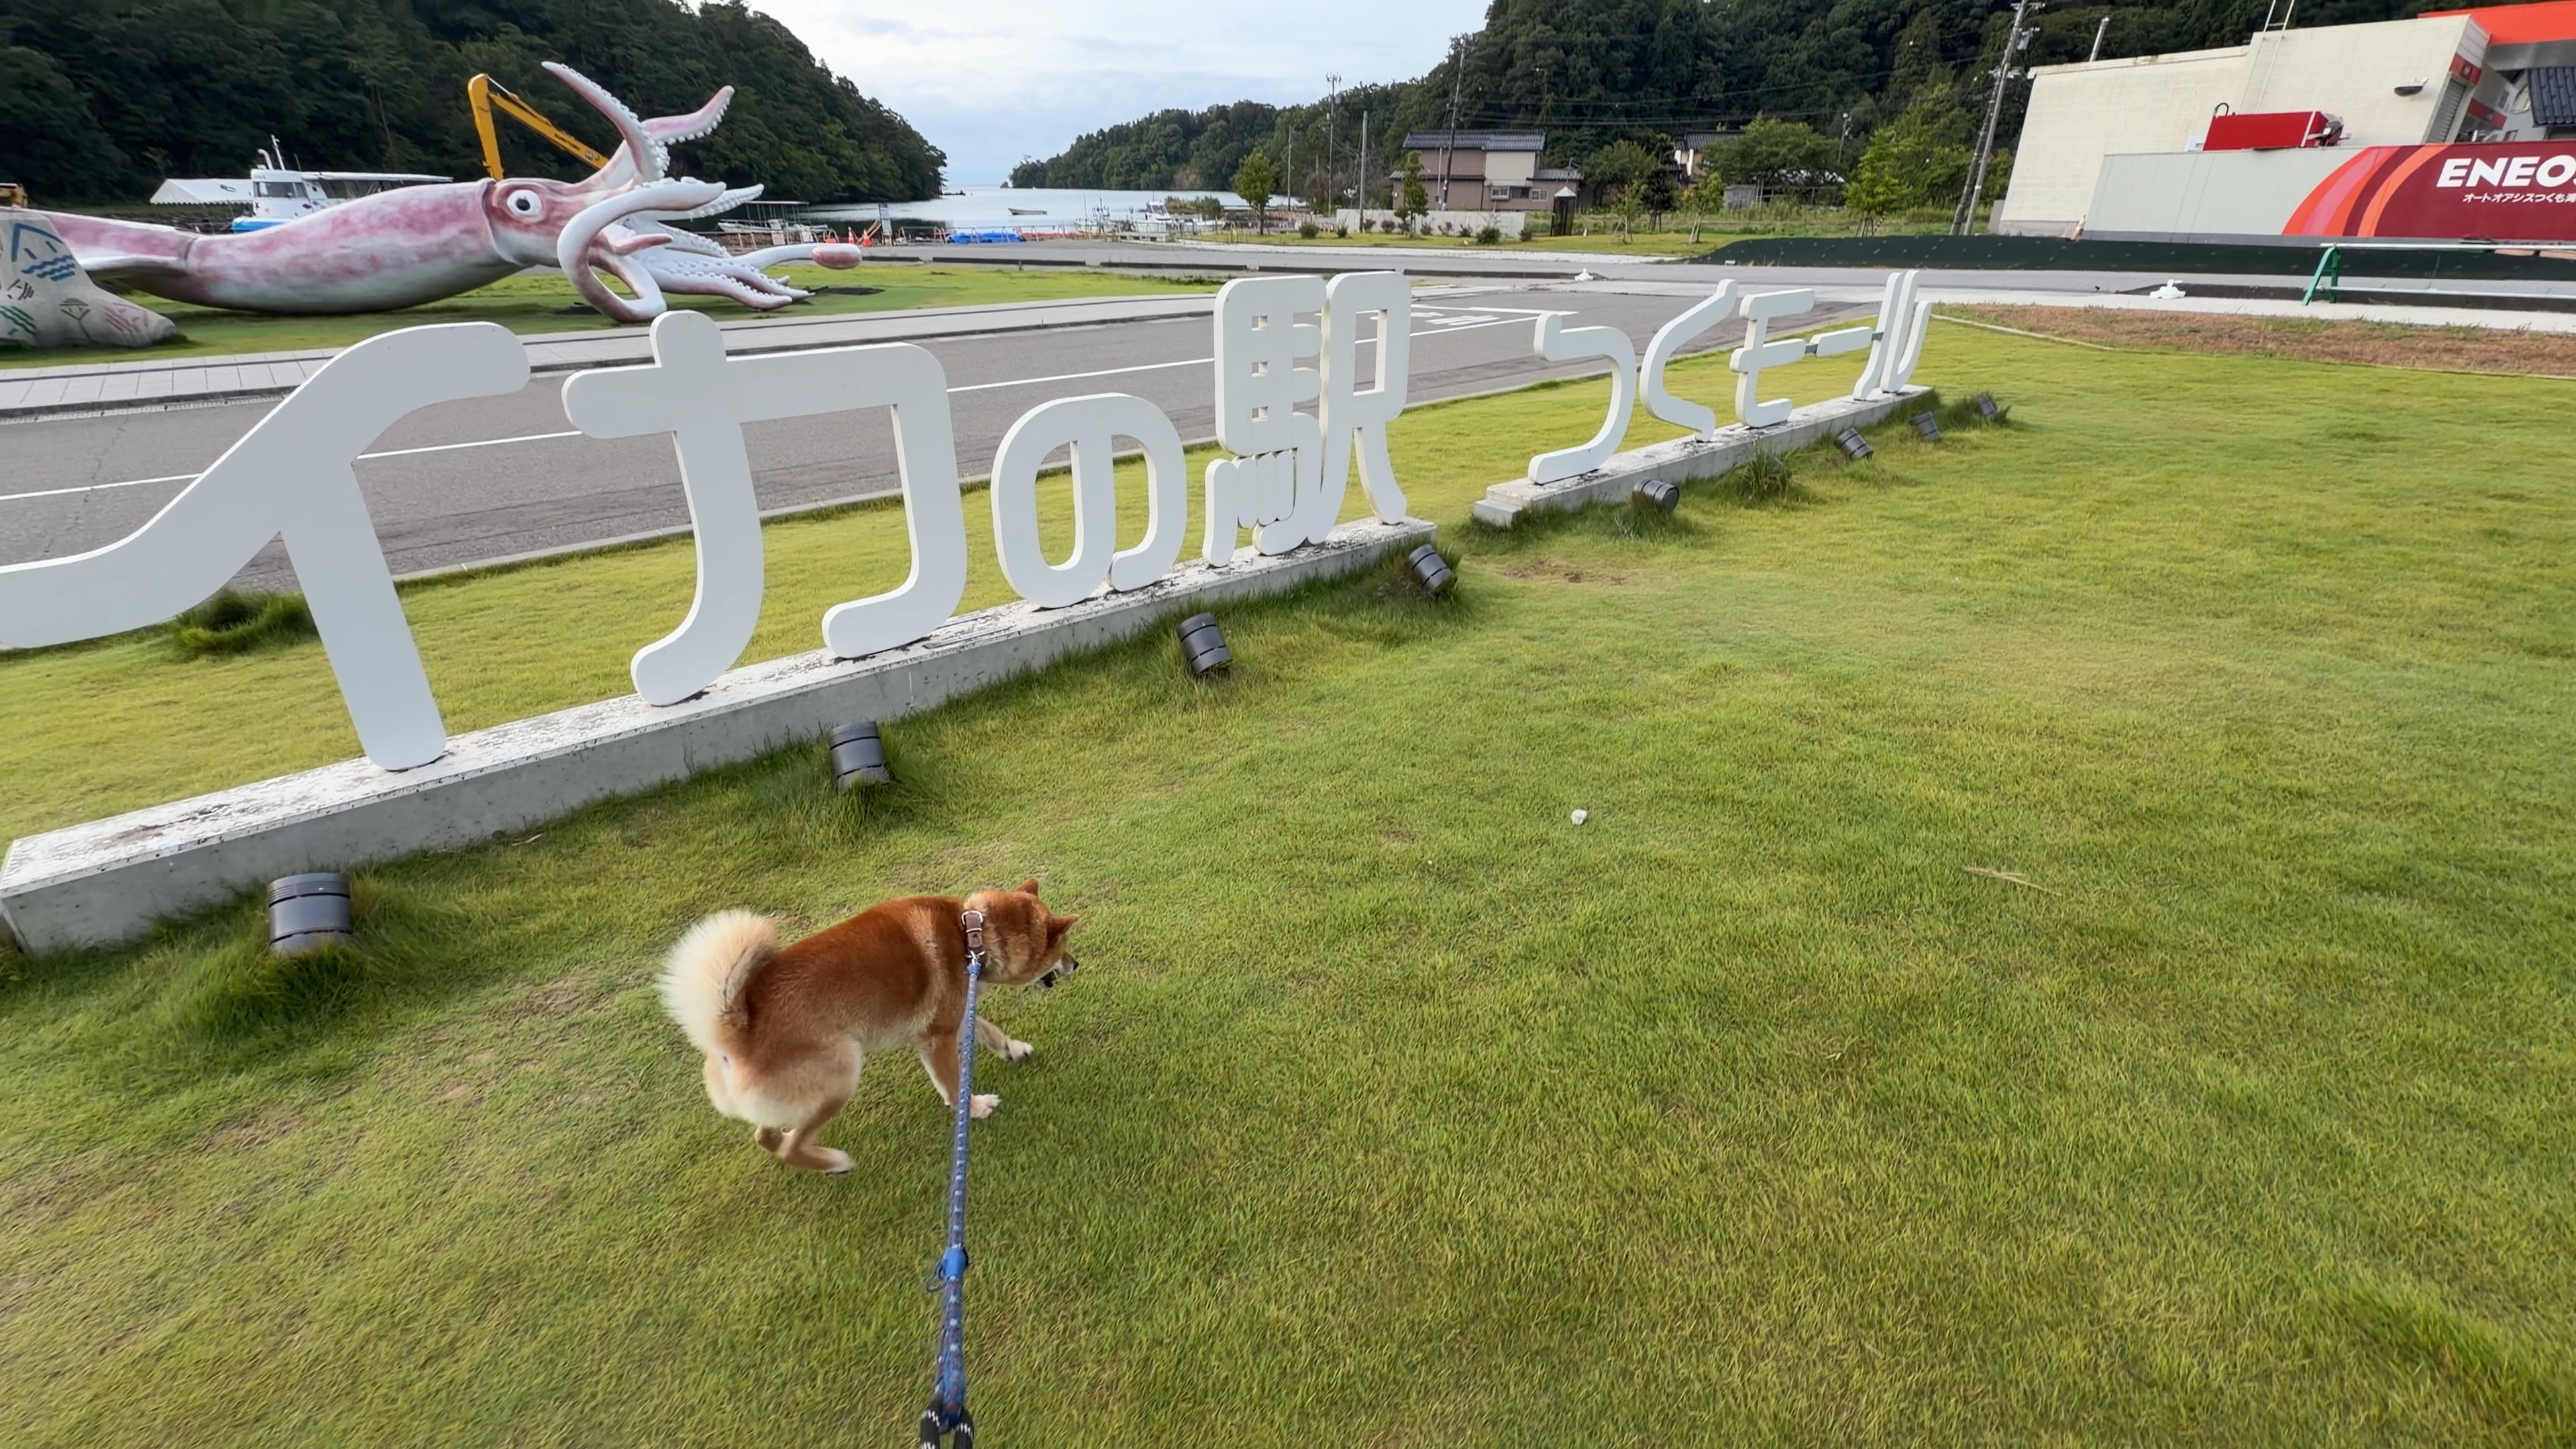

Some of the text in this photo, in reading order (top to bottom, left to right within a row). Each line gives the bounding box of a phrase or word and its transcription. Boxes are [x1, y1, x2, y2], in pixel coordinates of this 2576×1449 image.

[2436, 155, 2576, 188] ENEO
[0, 270, 1932, 772] イカの駅 つくモール
